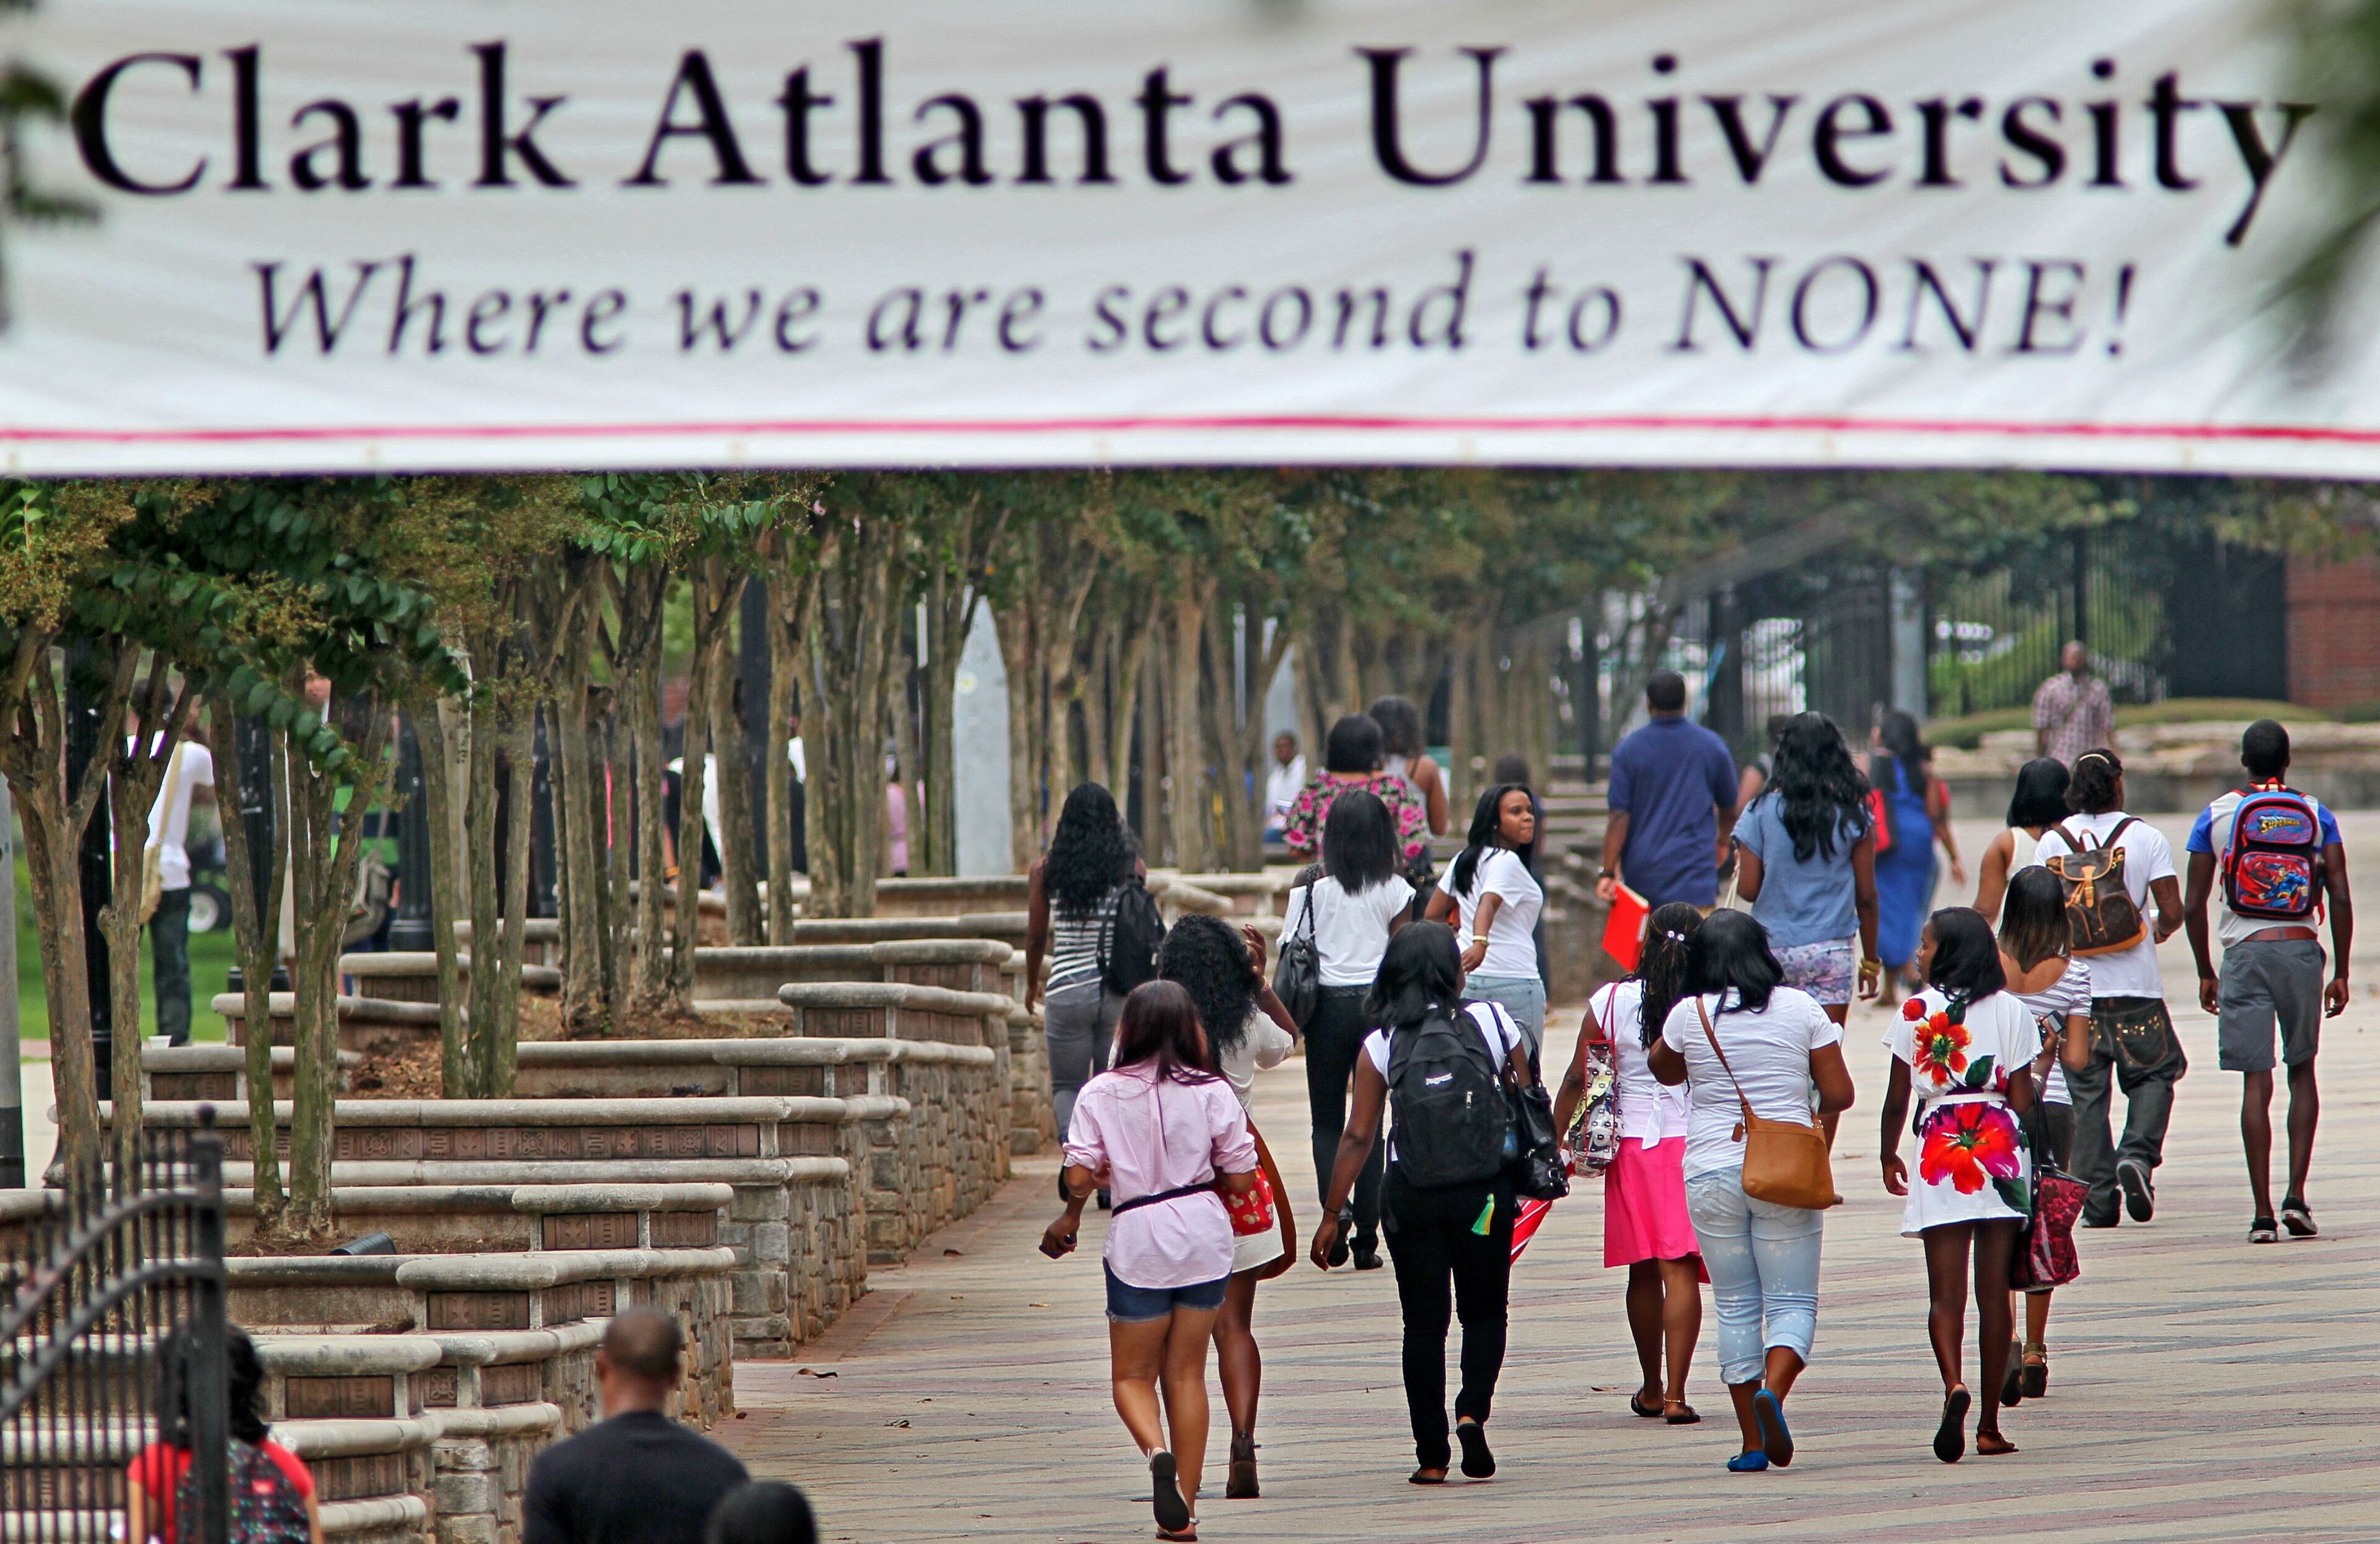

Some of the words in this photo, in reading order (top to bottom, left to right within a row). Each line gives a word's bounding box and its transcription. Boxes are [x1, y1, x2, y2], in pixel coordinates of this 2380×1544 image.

[69, 40, 579, 196] Clark
[618, 36, 1295, 188] Atlanta
[1352, 46, 2319, 247] University
[249, 251, 628, 355] Where
[674, 288, 822, 354] we
[867, 288, 1046, 353] are
[1087, 247, 1475, 353] second
[1525, 264, 1621, 352] to
[1662, 255, 2136, 356] NONE!
